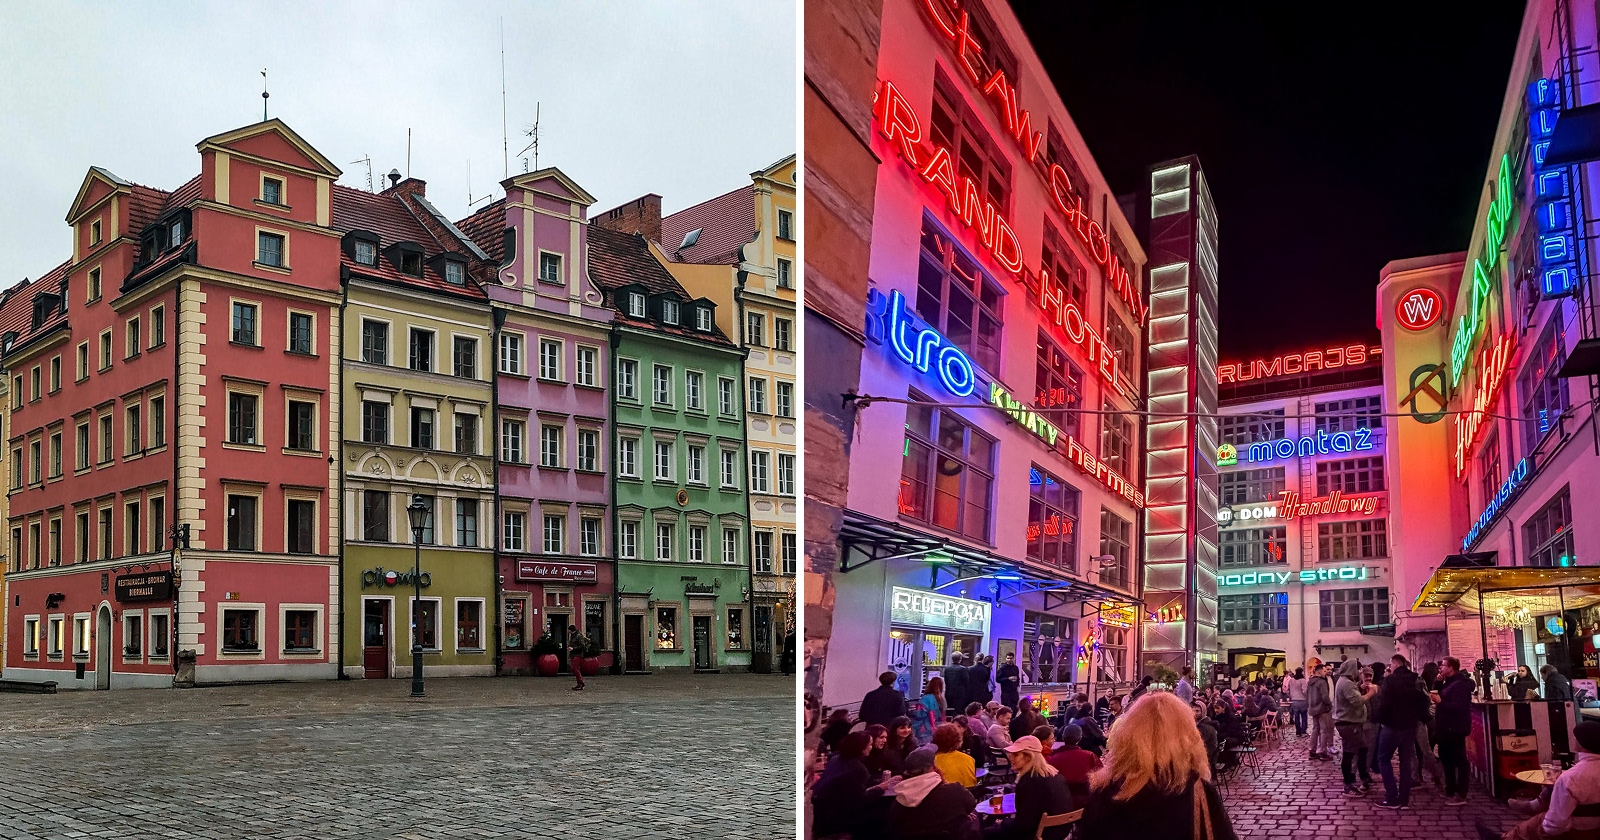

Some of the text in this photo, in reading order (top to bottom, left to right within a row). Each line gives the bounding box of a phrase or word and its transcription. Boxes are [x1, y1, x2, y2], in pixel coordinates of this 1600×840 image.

[866, 80, 1125, 396] RAND HOTEL
[1052, 163, 1149, 328] GŁÓWNY
[990, 381, 1058, 446] KWIATY
[1248, 427, 1373, 463] montaż
[1067, 435, 1144, 509] hermes
[1240, 490, 1378, 521] DOM Handlowy
